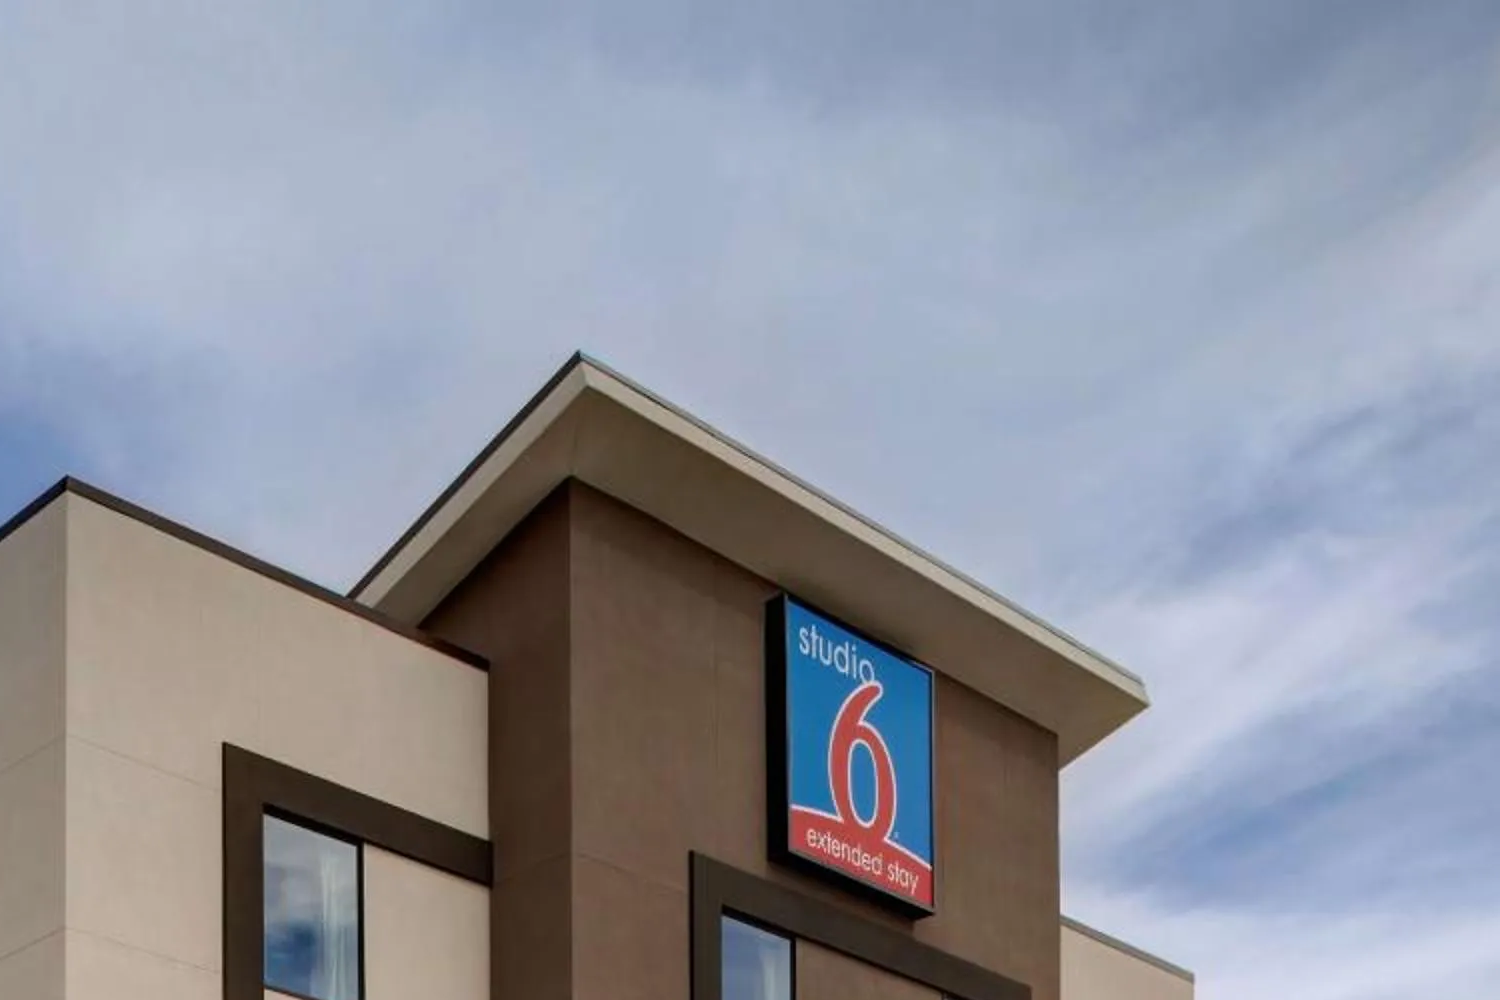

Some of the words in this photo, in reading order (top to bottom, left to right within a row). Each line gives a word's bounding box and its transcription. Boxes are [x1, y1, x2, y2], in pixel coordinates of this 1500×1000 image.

[799, 624, 875, 684] studio
[827, 681, 897, 840] 6
[806, 828, 884, 876] extended
[887, 861, 919, 895] stay
